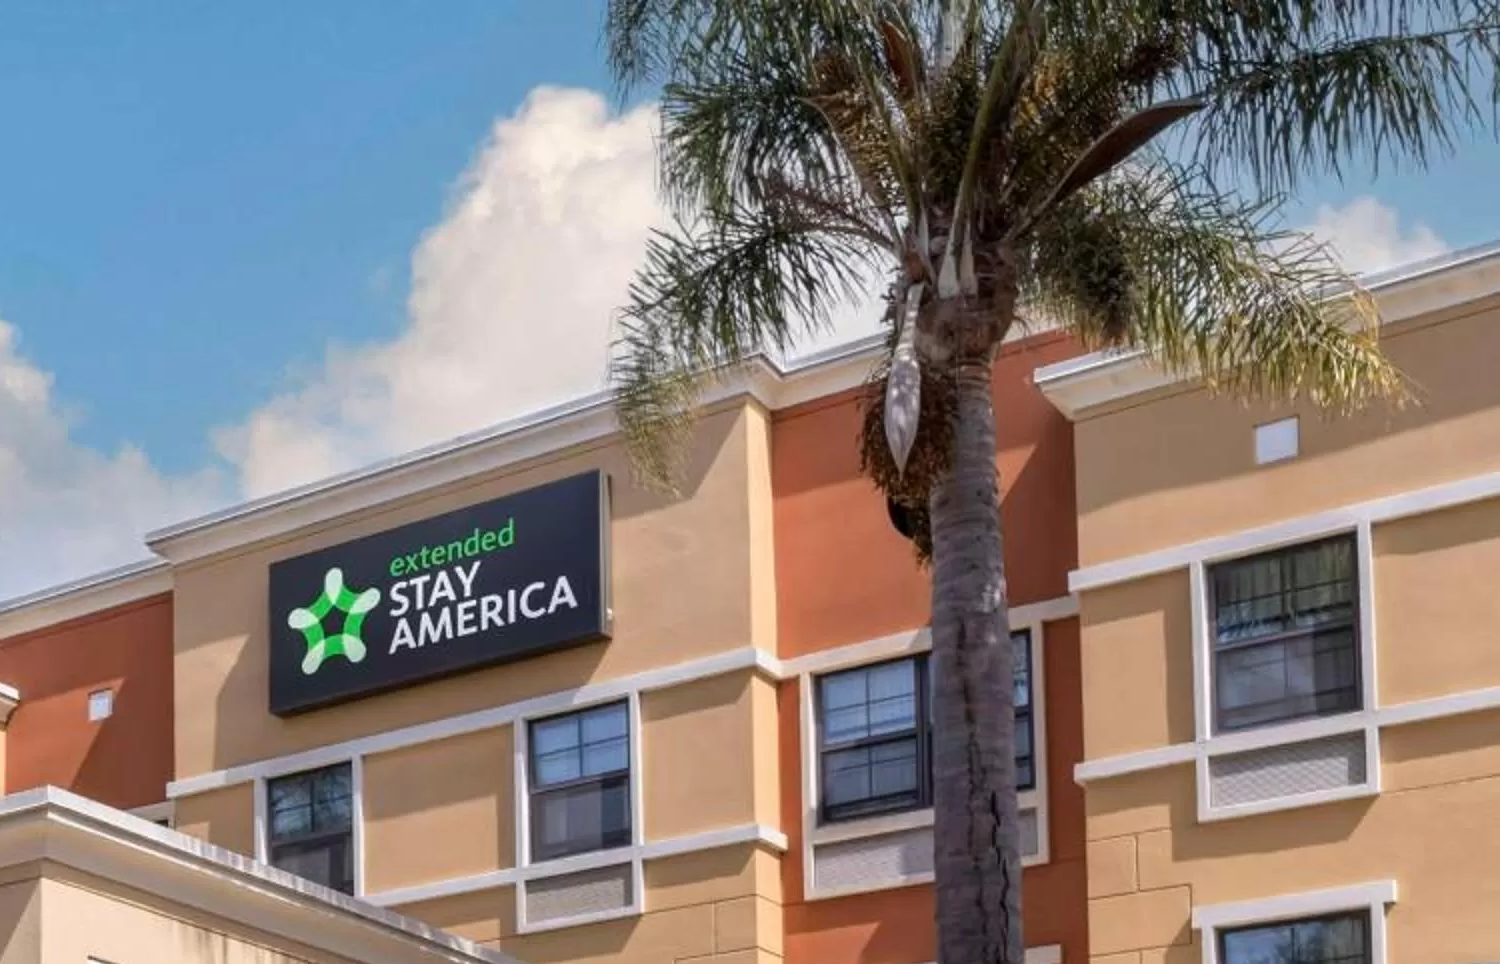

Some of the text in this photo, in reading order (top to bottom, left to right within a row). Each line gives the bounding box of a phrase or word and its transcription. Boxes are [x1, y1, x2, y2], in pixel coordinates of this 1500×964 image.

[390, 519, 515, 577] extended
[388, 576, 578, 655] AMERICA
[389, 561, 481, 616] STAY
